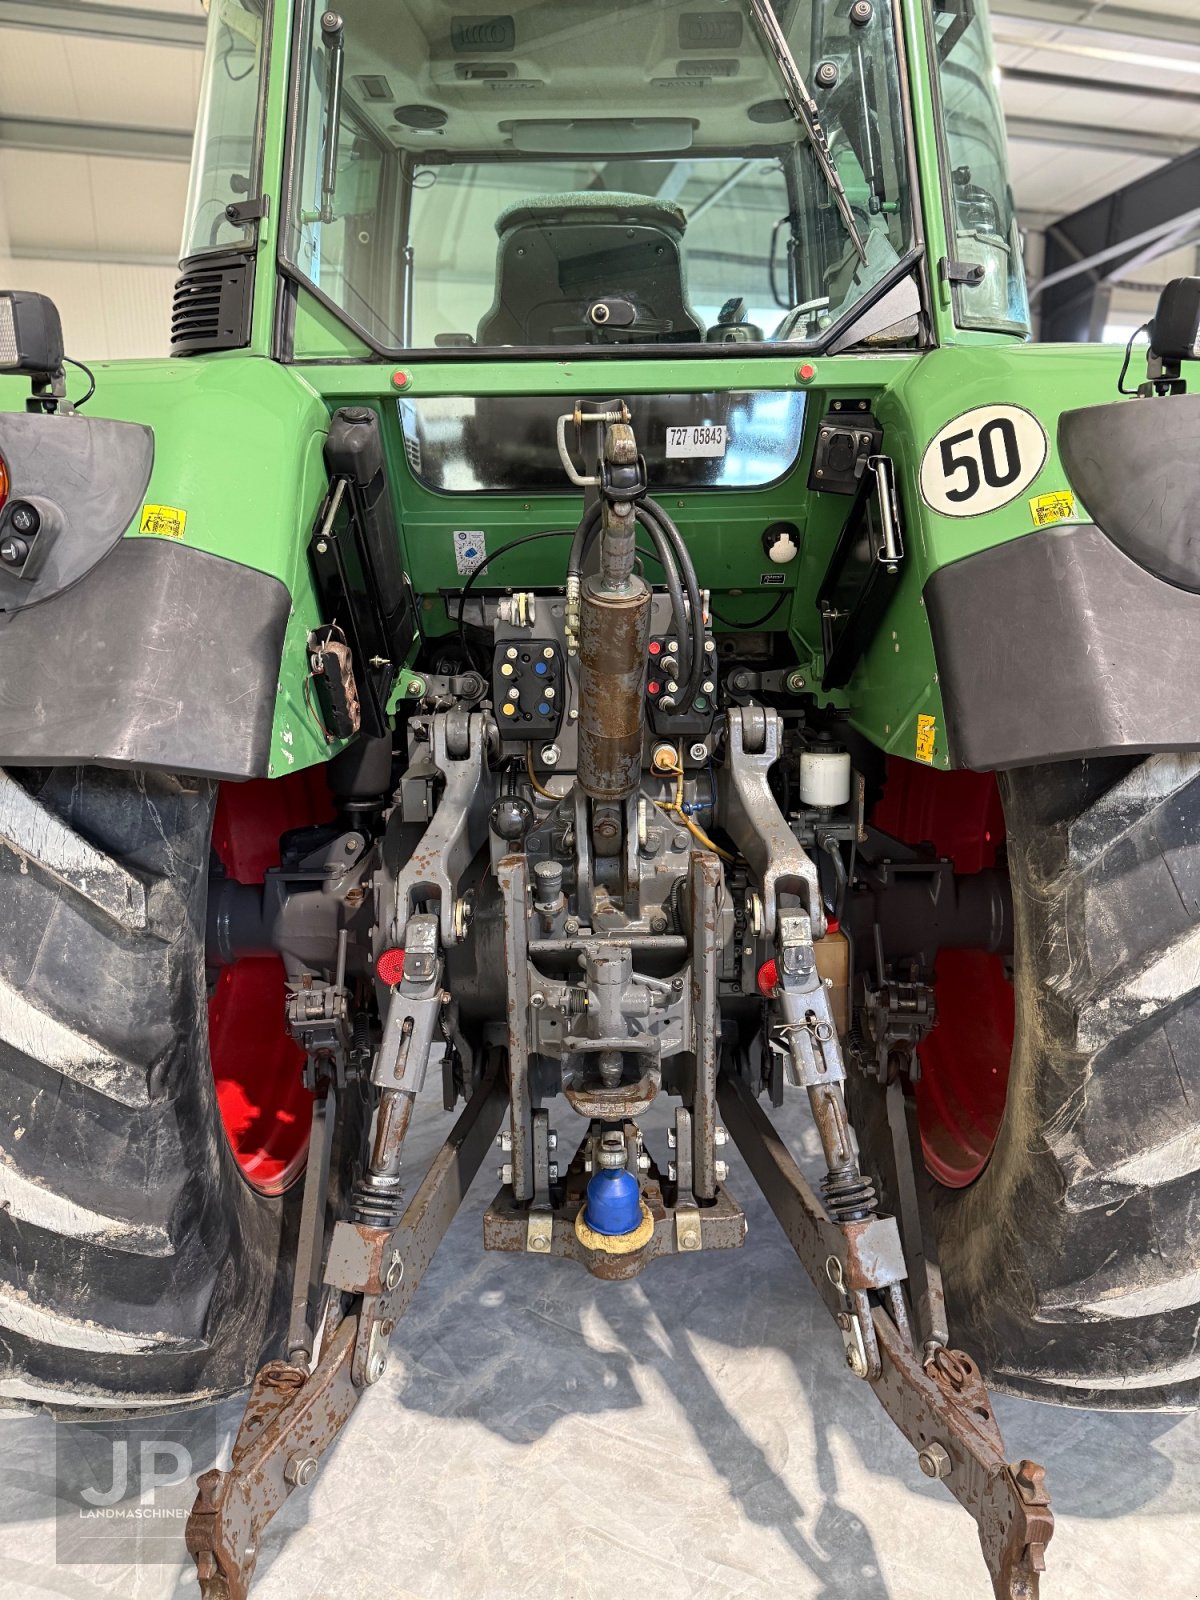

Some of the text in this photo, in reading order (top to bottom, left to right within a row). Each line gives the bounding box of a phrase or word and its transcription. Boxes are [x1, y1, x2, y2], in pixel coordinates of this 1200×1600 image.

[670, 427, 722, 446] 727 05843
[939, 417, 1022, 503] 50
